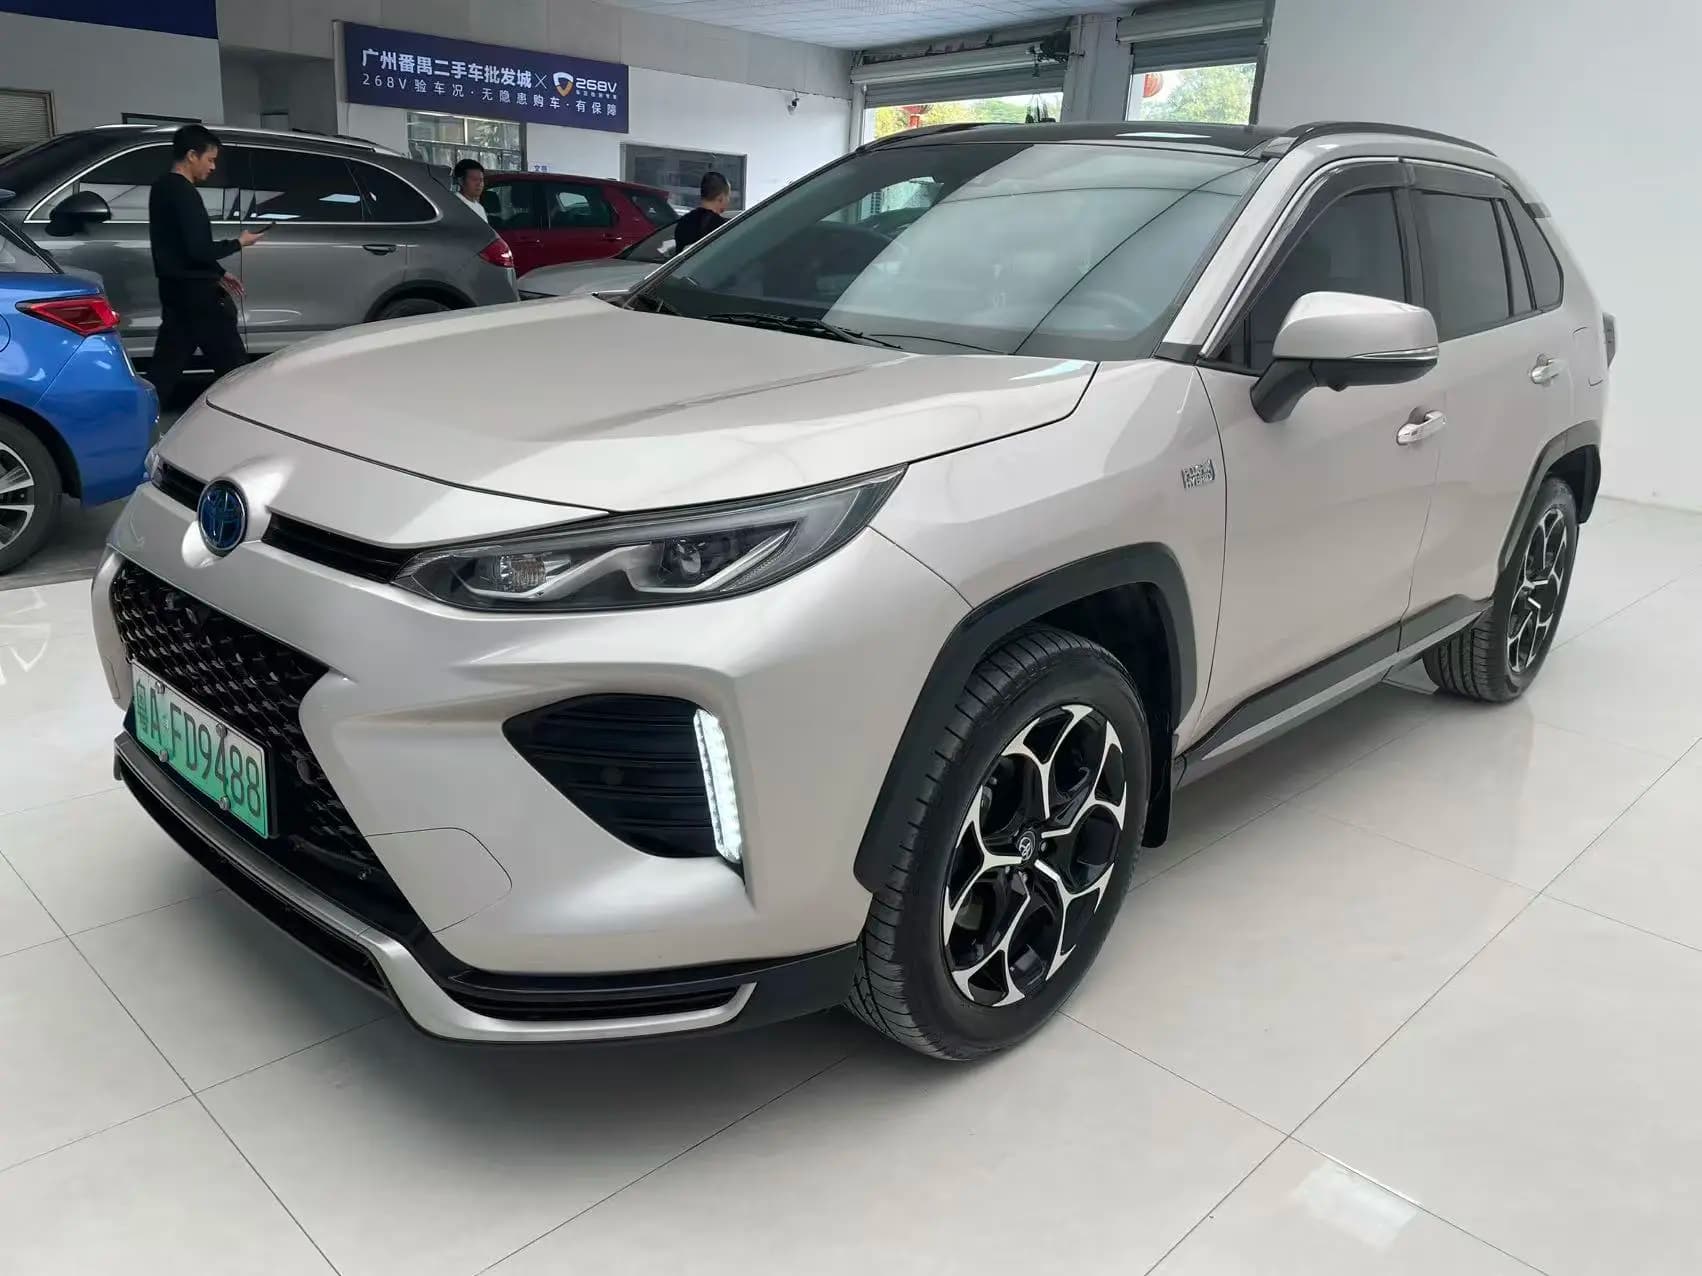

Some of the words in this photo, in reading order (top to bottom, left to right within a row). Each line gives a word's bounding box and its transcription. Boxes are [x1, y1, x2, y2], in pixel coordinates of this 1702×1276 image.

[361, 48, 532, 89] 广州番禺二手车批发城
[575, 77, 617, 93] 268V
[362, 73, 407, 89] 268V
